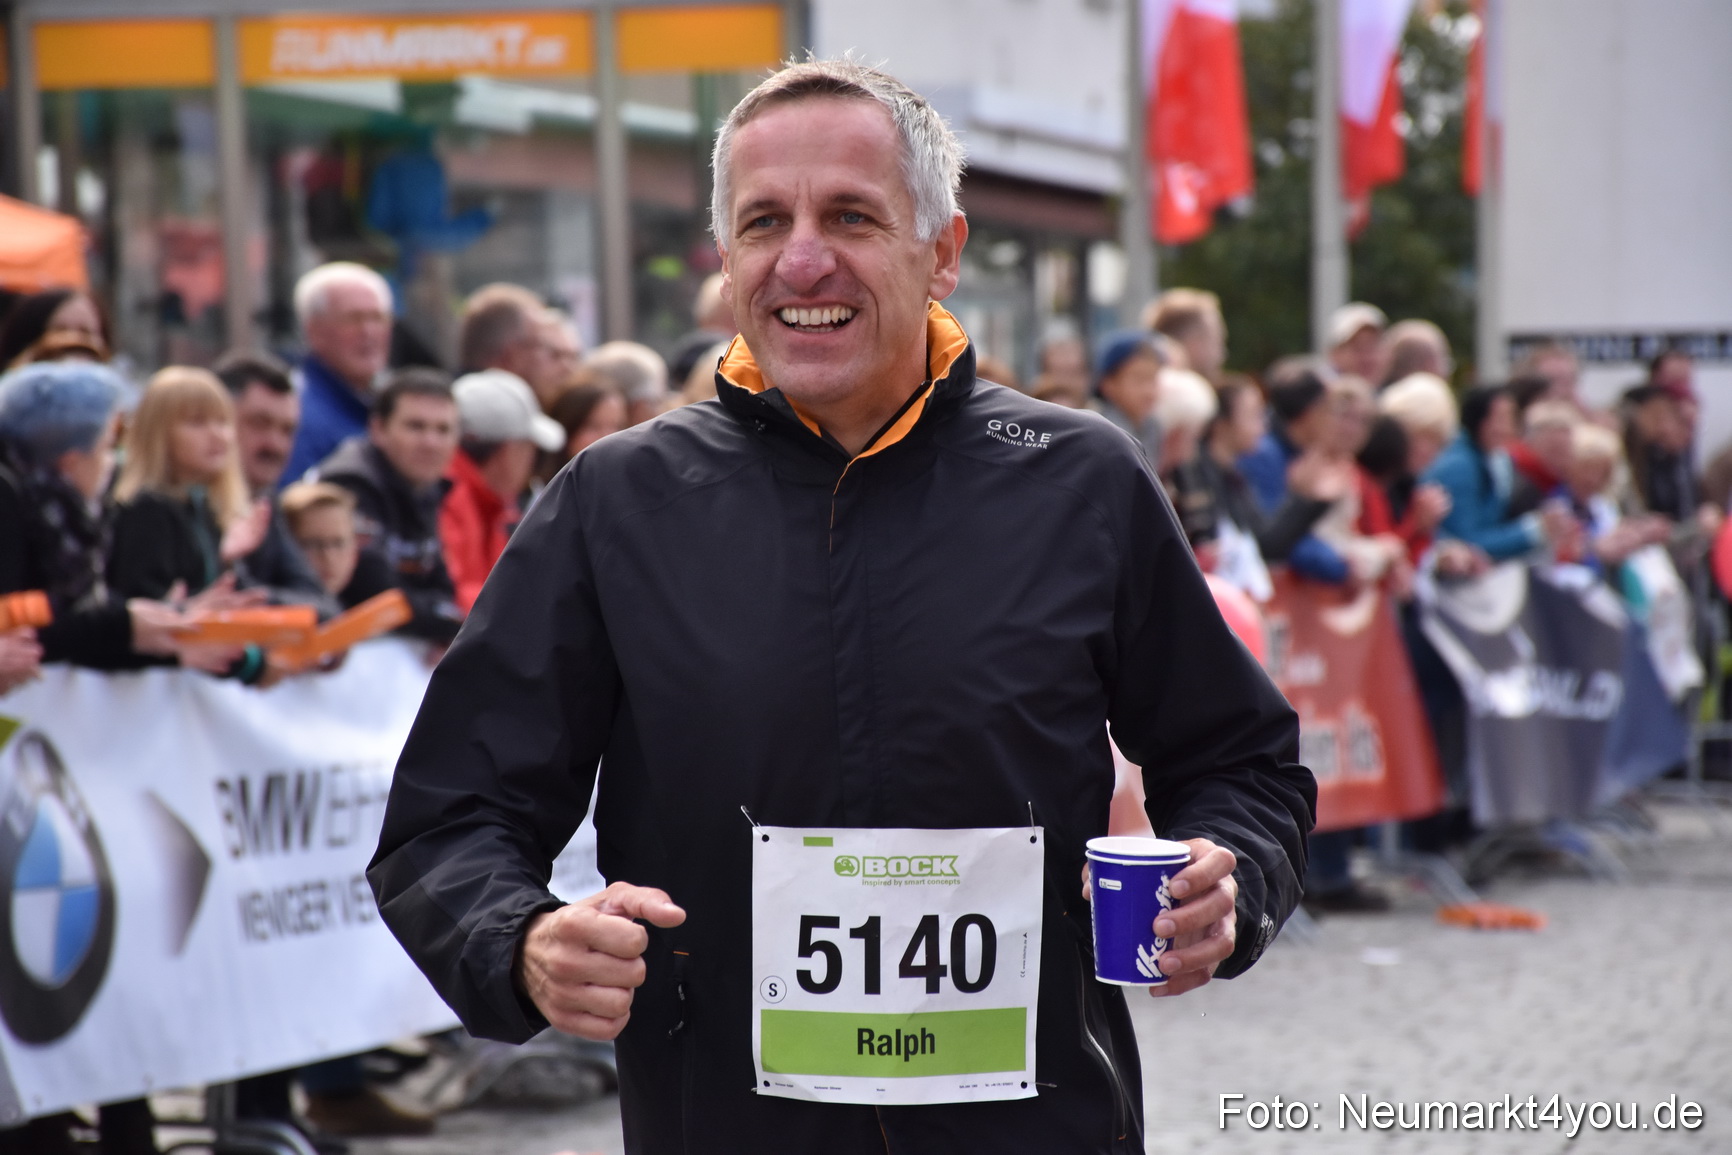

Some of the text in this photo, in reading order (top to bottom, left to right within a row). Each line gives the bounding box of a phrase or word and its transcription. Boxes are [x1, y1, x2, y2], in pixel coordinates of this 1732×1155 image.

[986, 430, 1048, 450] RUNNING WEAR
[987, 419, 1052, 443] GORE
[862, 855, 960, 877] BOCK
[862, 878, 892, 887] inspired
[894, 878, 903, 887] by
[927, 878, 961, 887] concepts
[796, 913, 997, 995] 5140
[768, 983, 778, 997] S
[857, 1027, 936, 1062] Ralph
